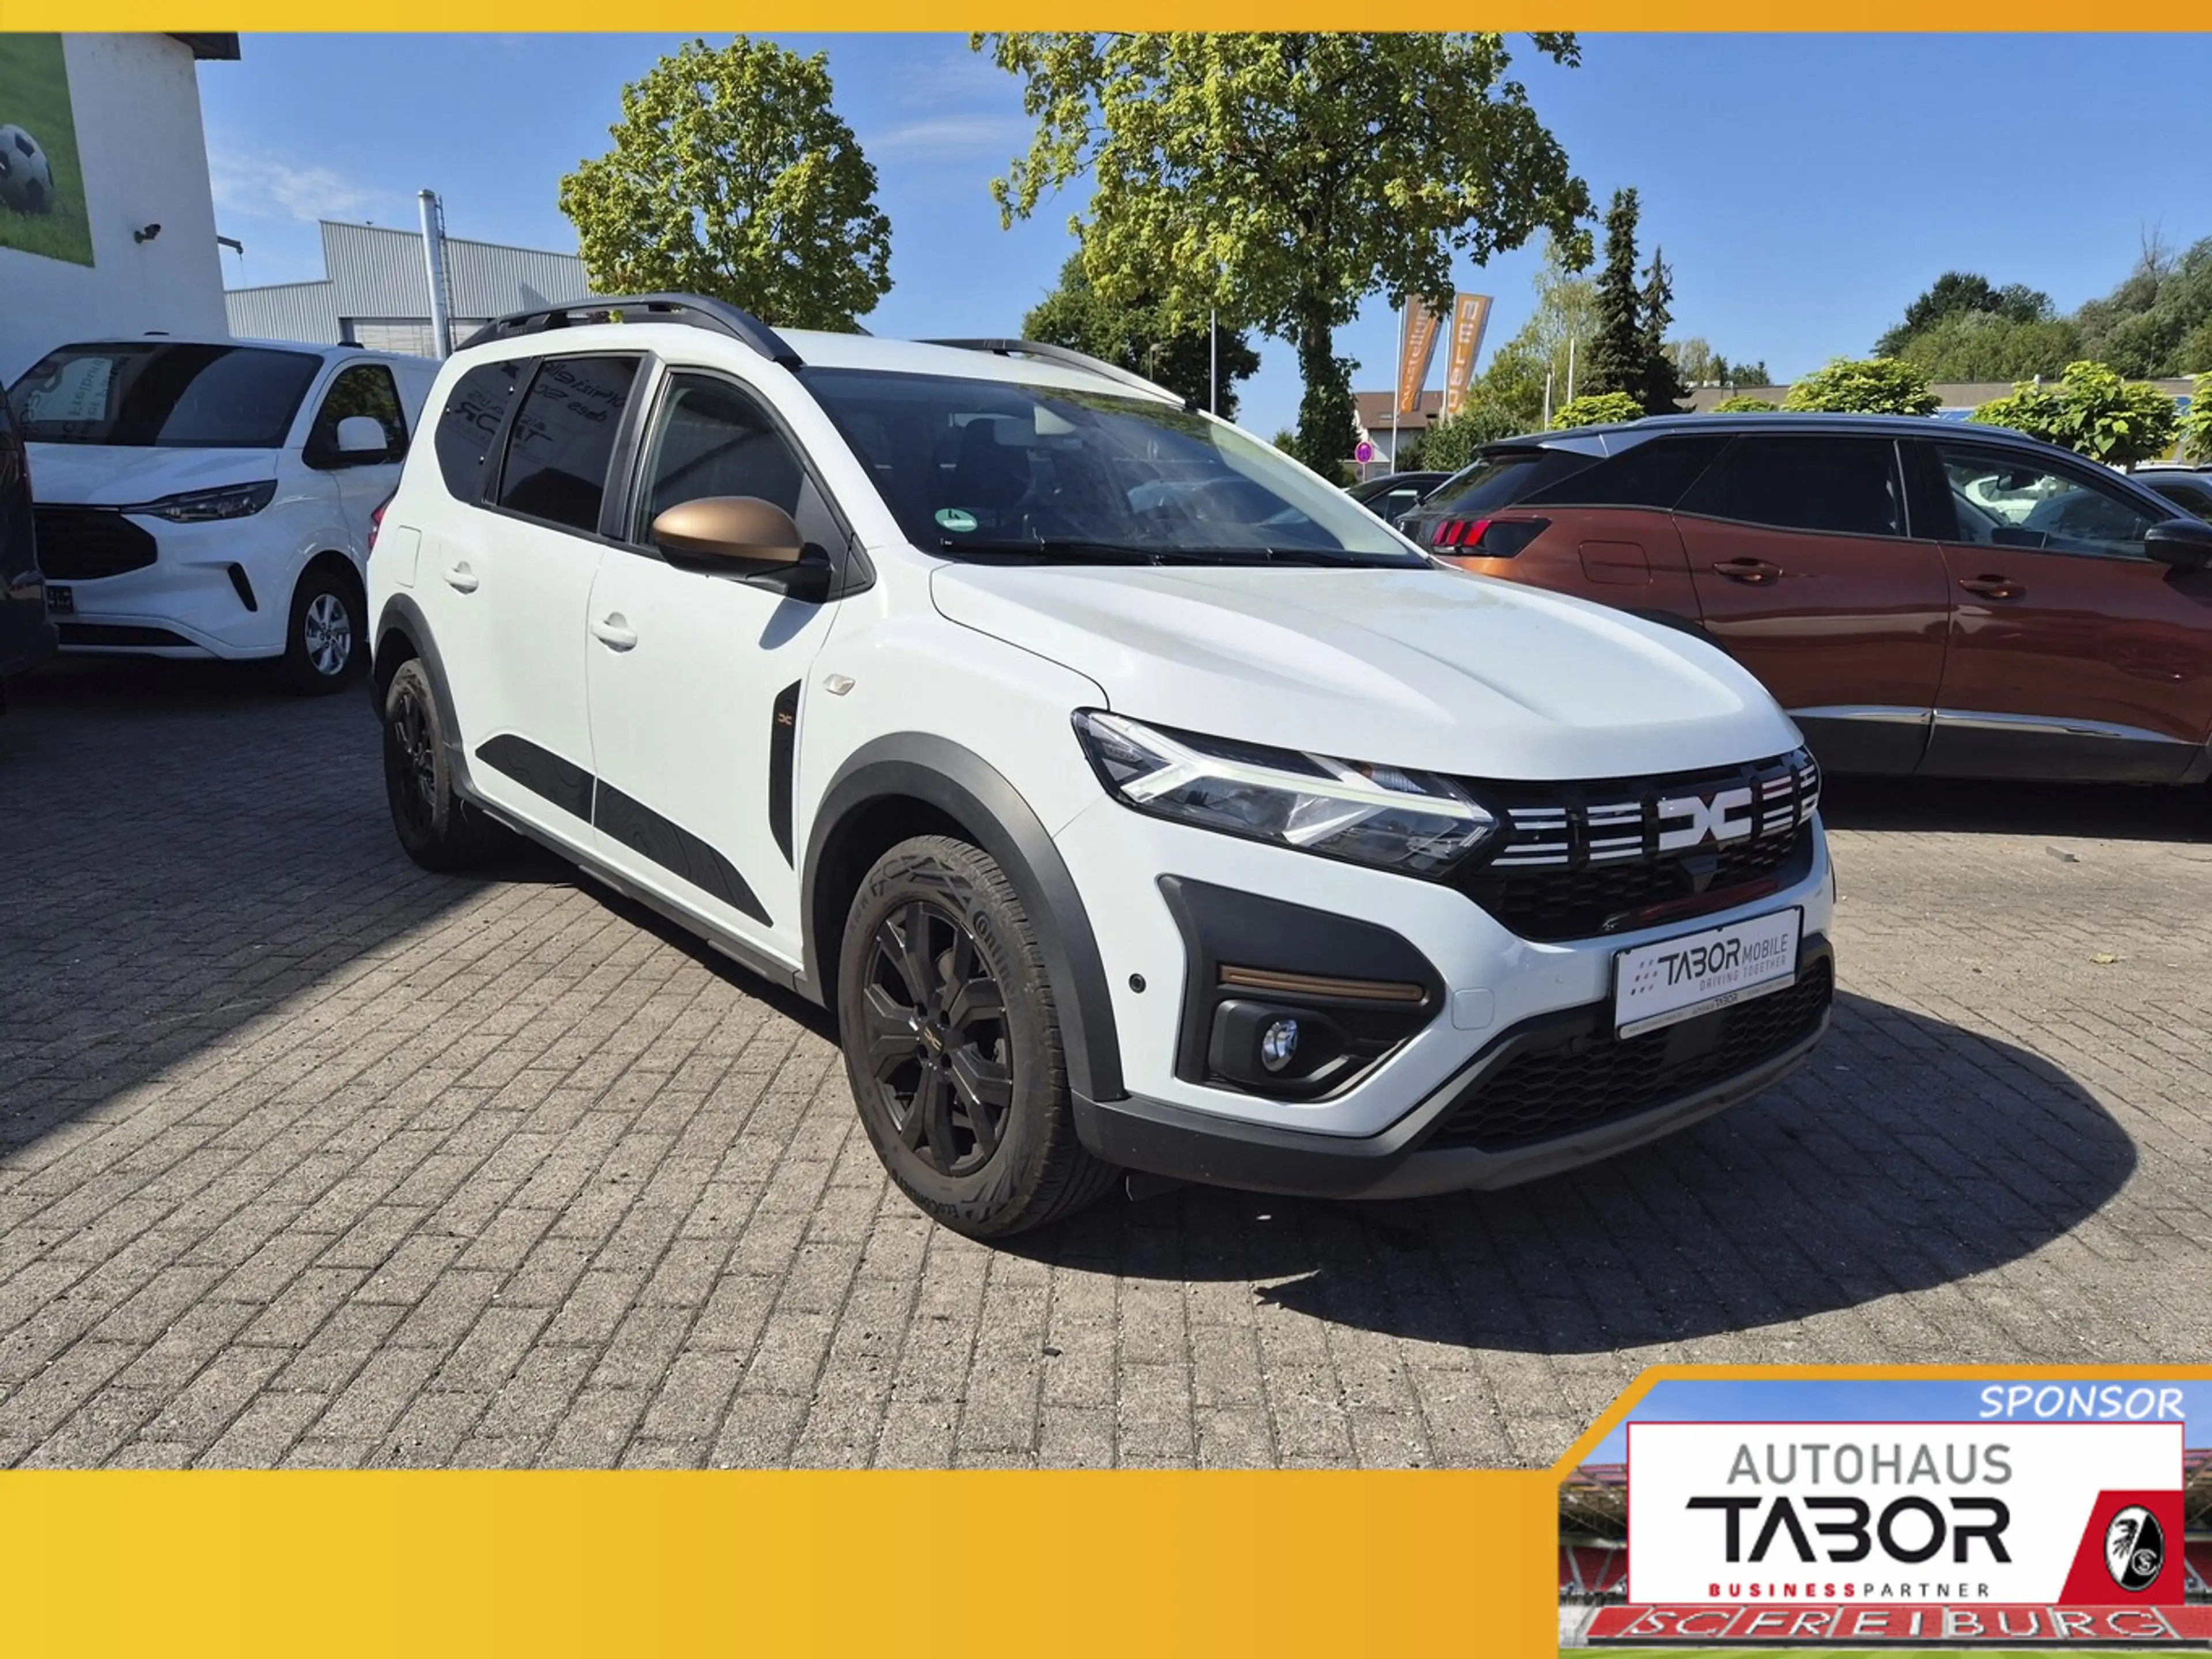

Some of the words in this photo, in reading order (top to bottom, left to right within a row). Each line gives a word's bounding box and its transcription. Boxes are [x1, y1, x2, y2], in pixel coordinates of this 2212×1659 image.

[1658, 937, 1742, 986] TABOR
[1742, 933, 1788, 964] MOBILE
[1699, 969, 1740, 991] DRIVING
[1743, 955, 1787, 979] TOGETHER
